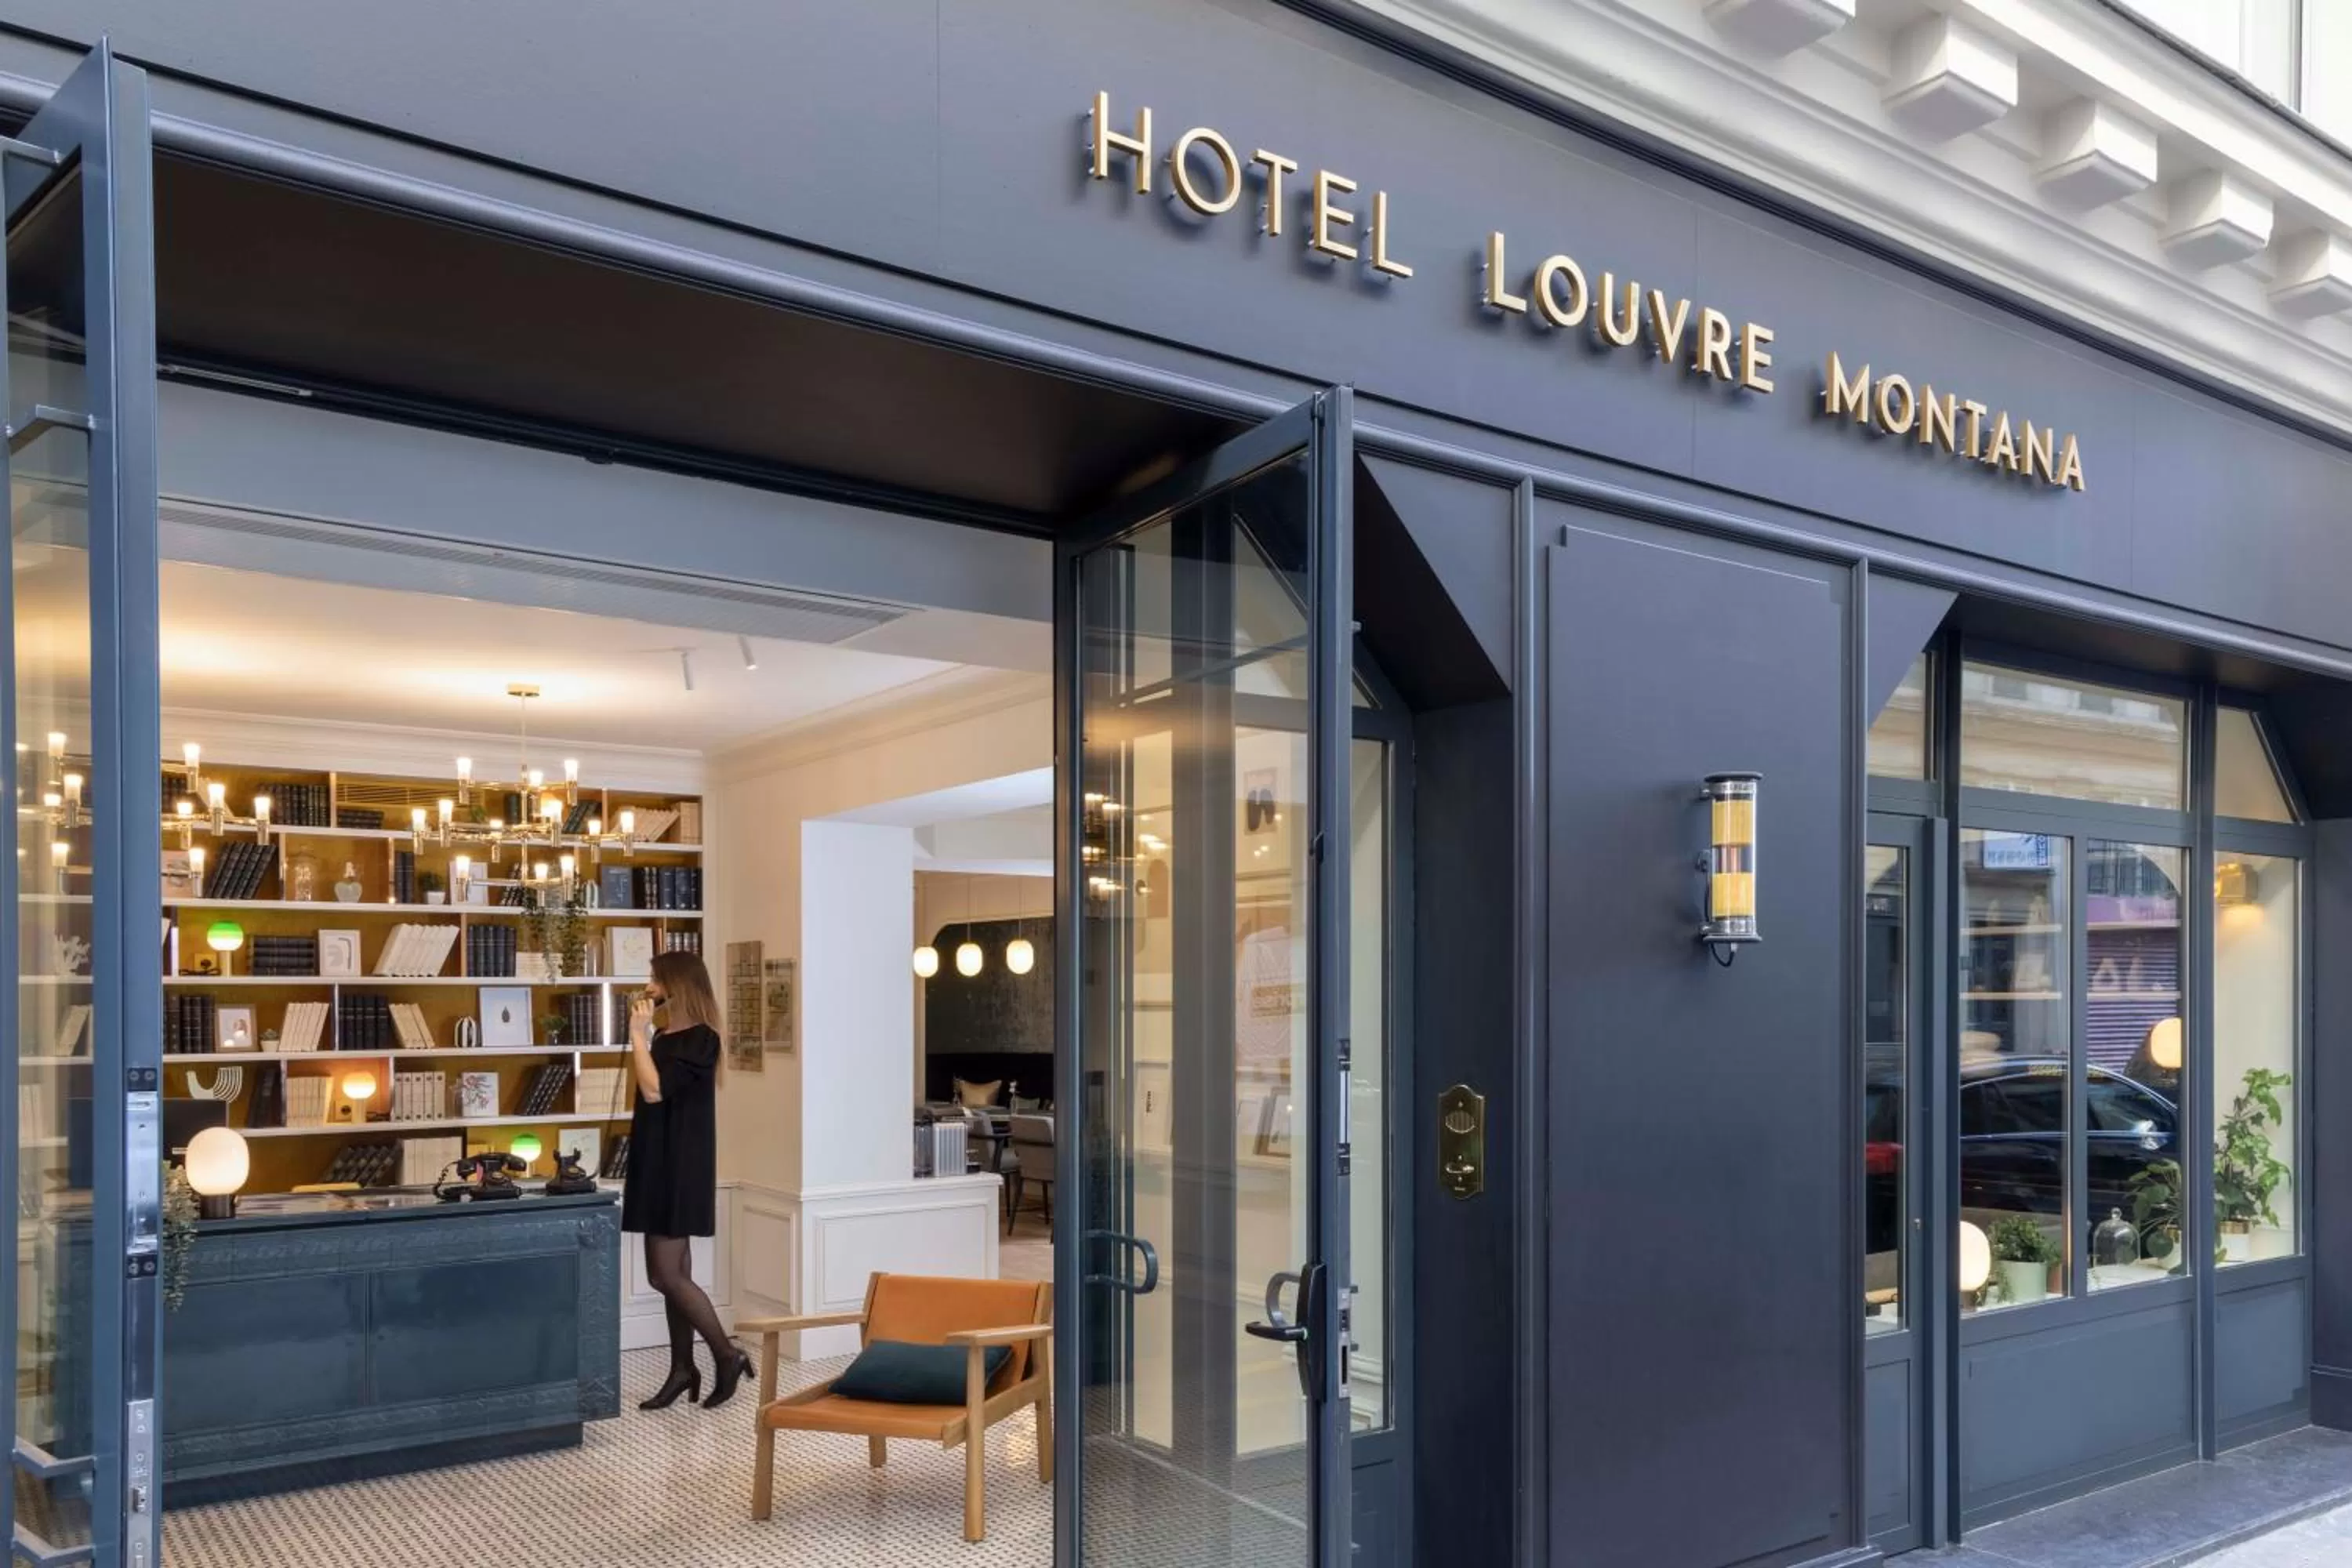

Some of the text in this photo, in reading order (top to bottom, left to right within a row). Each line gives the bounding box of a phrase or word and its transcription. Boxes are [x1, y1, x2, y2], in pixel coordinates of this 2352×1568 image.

[1094, 90, 2086, 492] HOTEL LOUVRE MONTANA
